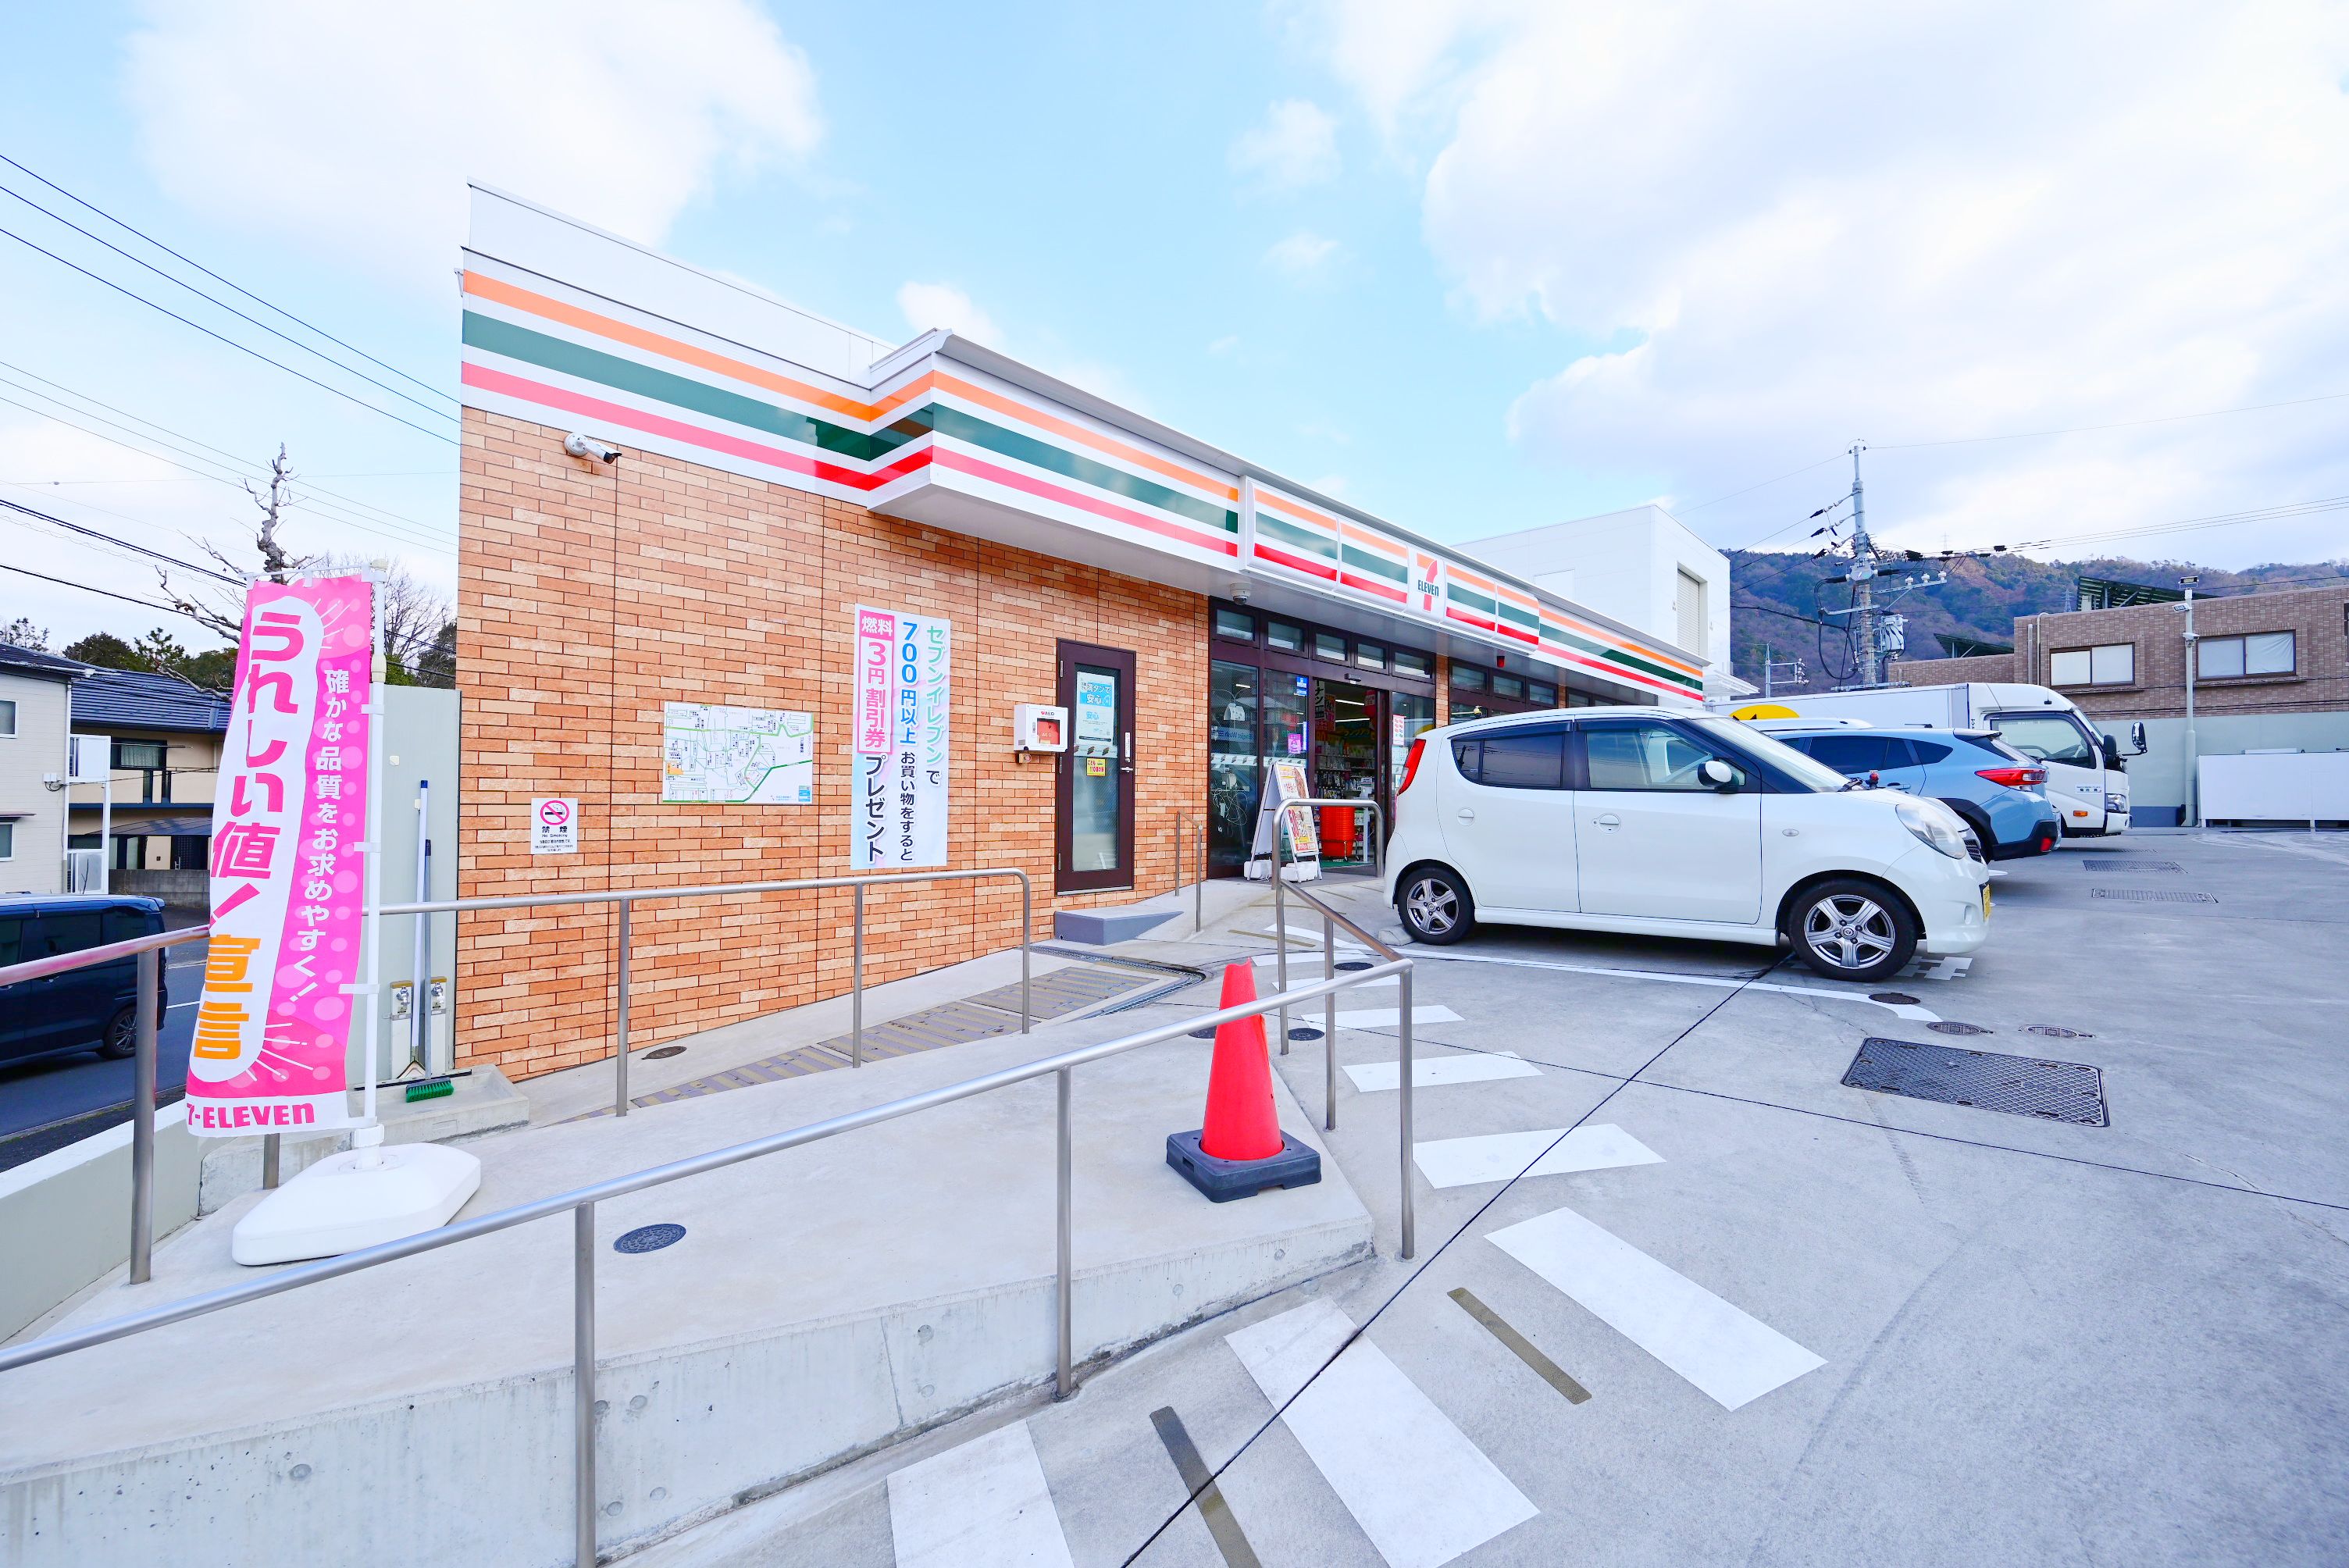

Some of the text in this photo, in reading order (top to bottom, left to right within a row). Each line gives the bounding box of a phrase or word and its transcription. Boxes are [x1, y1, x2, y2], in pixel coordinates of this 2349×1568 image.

[861, 615, 894, 637] 燃料
[1417, 579, 1438, 597] ELEVEn
[864, 641, 887, 749] 3円割引券
[926, 626, 946, 785] セブンイレブンで
[288, 668, 351, 1003] 確かな品質をお求めやすく！
[864, 754, 887, 864] プレゼント
[900, 750, 916, 862] お買い物をすると
